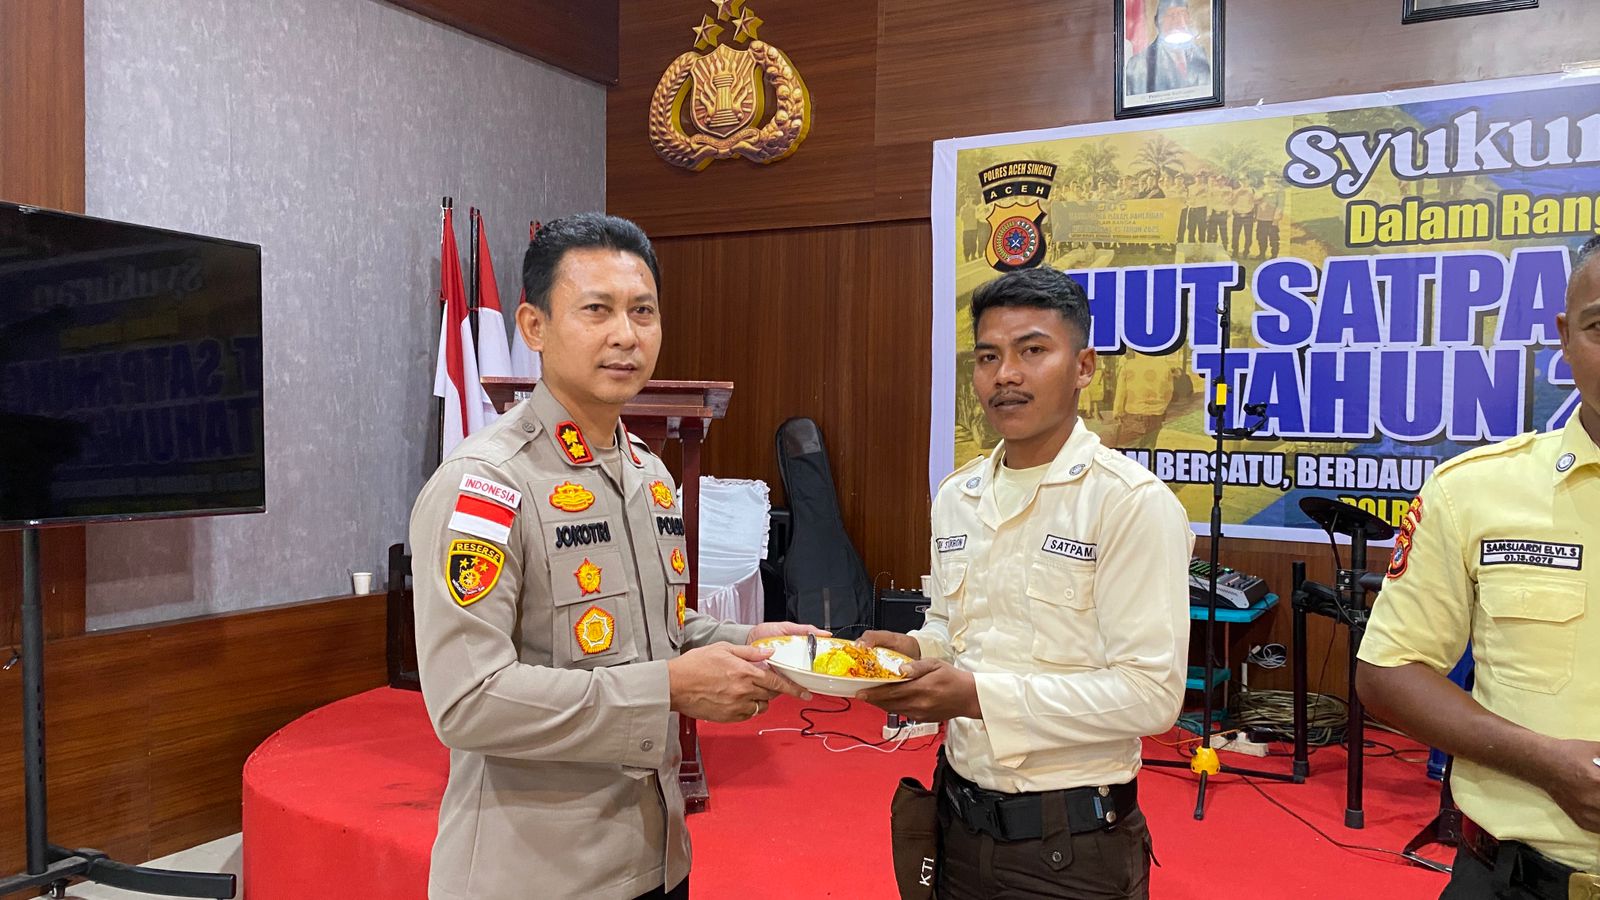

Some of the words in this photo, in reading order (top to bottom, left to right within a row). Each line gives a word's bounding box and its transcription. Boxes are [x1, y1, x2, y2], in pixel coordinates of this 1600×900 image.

[983, 165, 1008, 183] POLRES
[1008, 163, 1027, 176] ACEH
[1027, 163, 1053, 177] SINGKIL
[990, 185, 1044, 199] ACEH
[1350, 200, 1489, 244] Dalam
[1501, 193, 1600, 236] Ran
[1068, 263, 1237, 351] HUT
[1254, 247, 1571, 347] SATPA
[1194, 347, 1525, 440] TAHUN
[1156, 451, 1289, 488] BERSATU,
[464, 478, 515, 504] INDONESIA
[556, 521, 611, 548] JOKOTRI
[456, 543, 500, 561] RESERSE
[1050, 539, 1093, 557] SATPAM
[1486, 543, 1541, 554] SAMSUARDI
[1569, 547, 1577, 557] S
[919, 857, 934, 886] KTI
